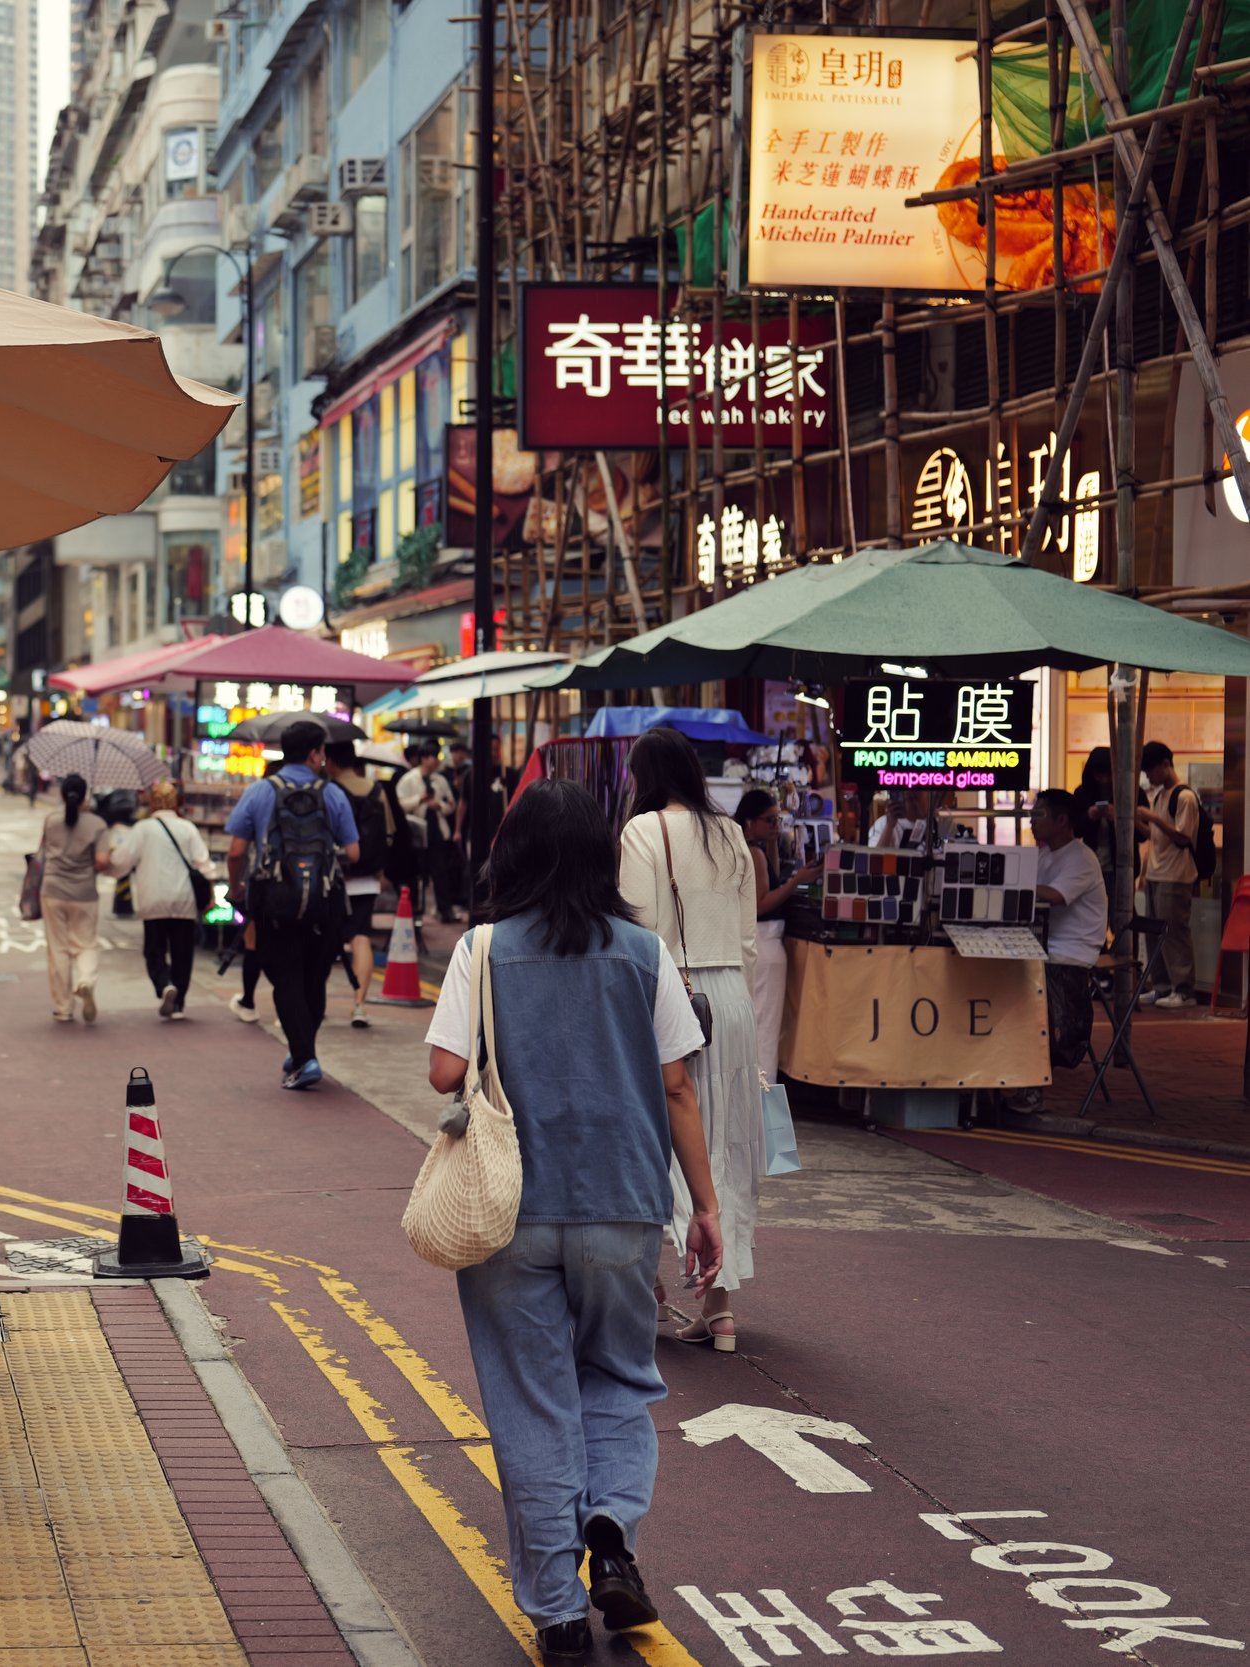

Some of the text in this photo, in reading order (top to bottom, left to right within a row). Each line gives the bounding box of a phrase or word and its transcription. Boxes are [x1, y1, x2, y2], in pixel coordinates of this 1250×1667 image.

[818, 47, 882, 87] 皇玥
[765, 91, 902, 105] IMPERIAL PATISSERIE
[763, 129, 888, 157] 全手工製作
[773, 160, 920, 190] 米芝蓮蝴蝶酥
[761, 204, 877, 223] Handcrafted
[755, 225, 915, 246] Michelin Palmier
[863, 682, 1014, 744] 貼膜
[854, 751, 1019, 767] IPAD IPHONE SAMSUNG
[877, 770, 994, 788] Tempered glass
[917, 1510, 1246, 1660] LOOK
